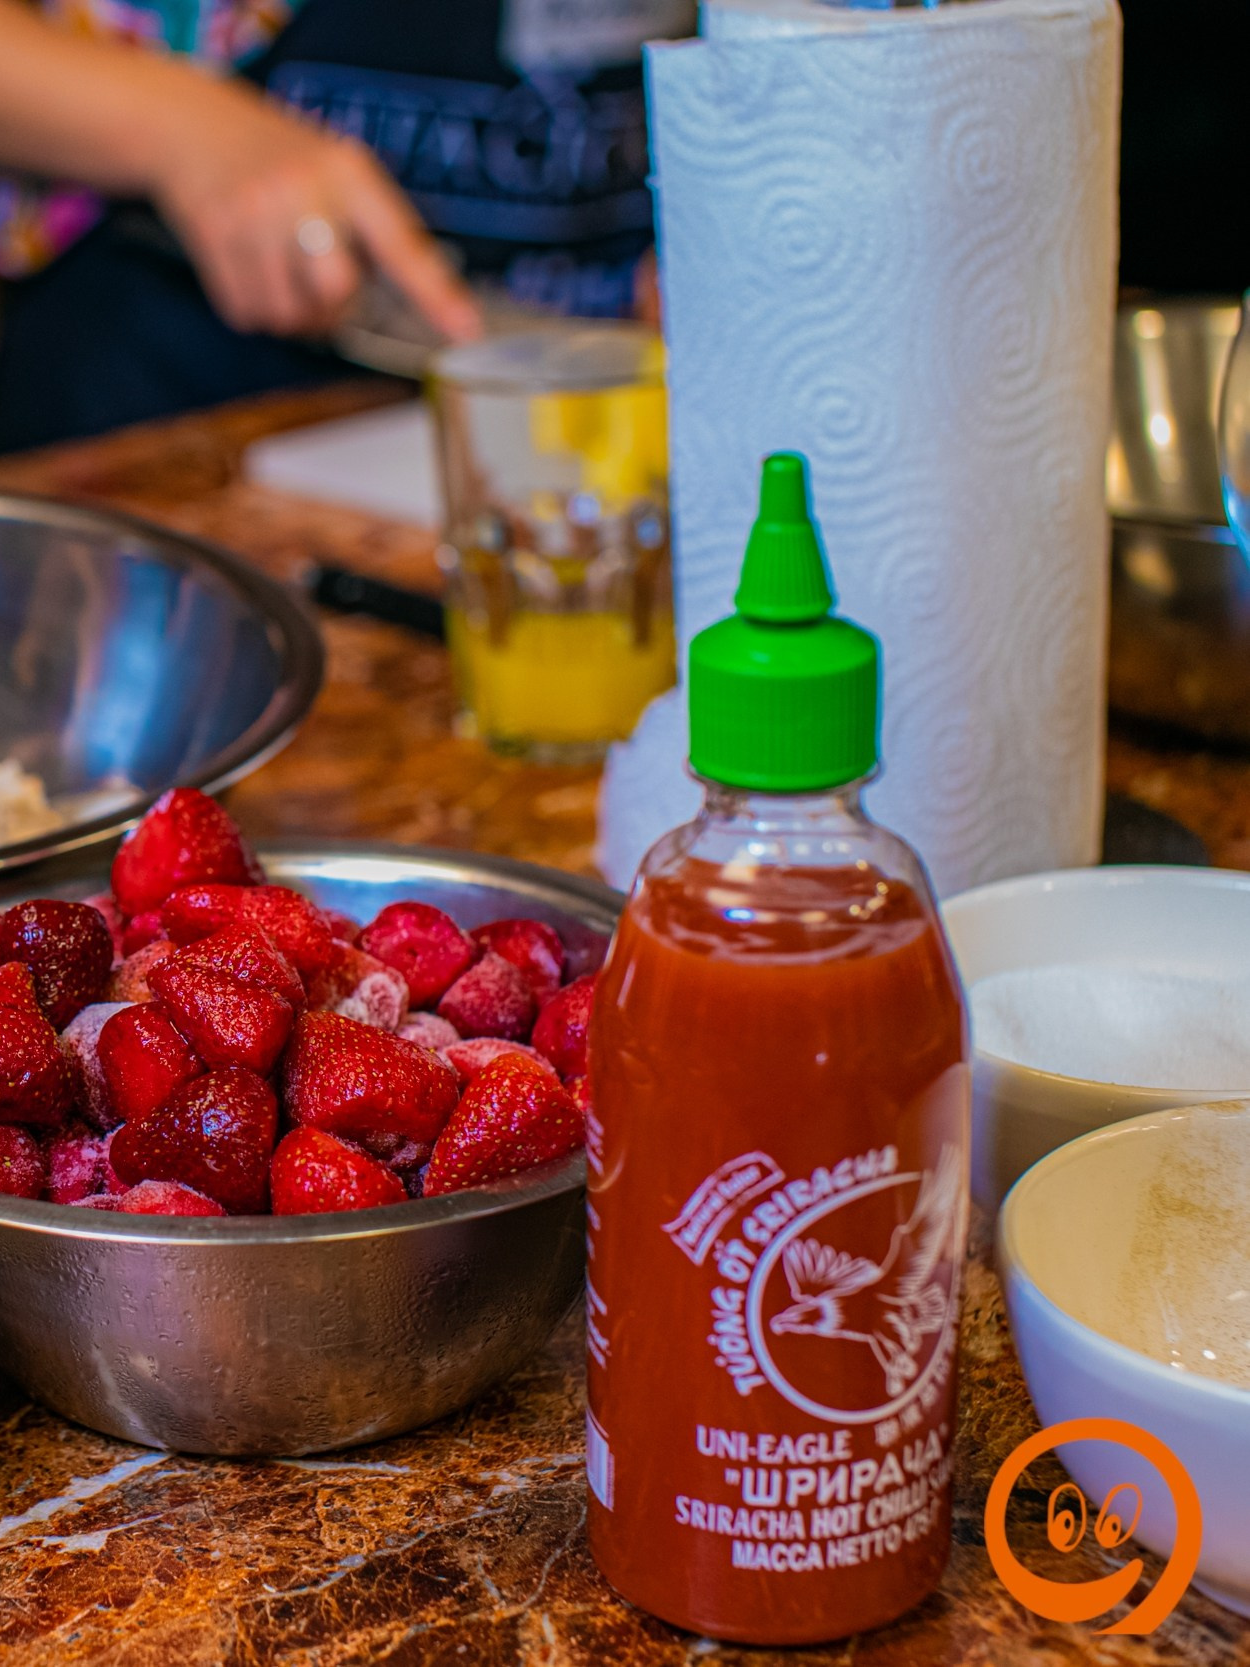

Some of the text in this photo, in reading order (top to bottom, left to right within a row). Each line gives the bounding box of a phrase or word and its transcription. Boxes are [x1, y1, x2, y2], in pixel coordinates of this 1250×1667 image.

[696, 1424, 853, 1465] UNI-EAGLE
[675, 1495, 806, 1541] SRIRACHA
[810, 1501, 865, 1540] HOT
